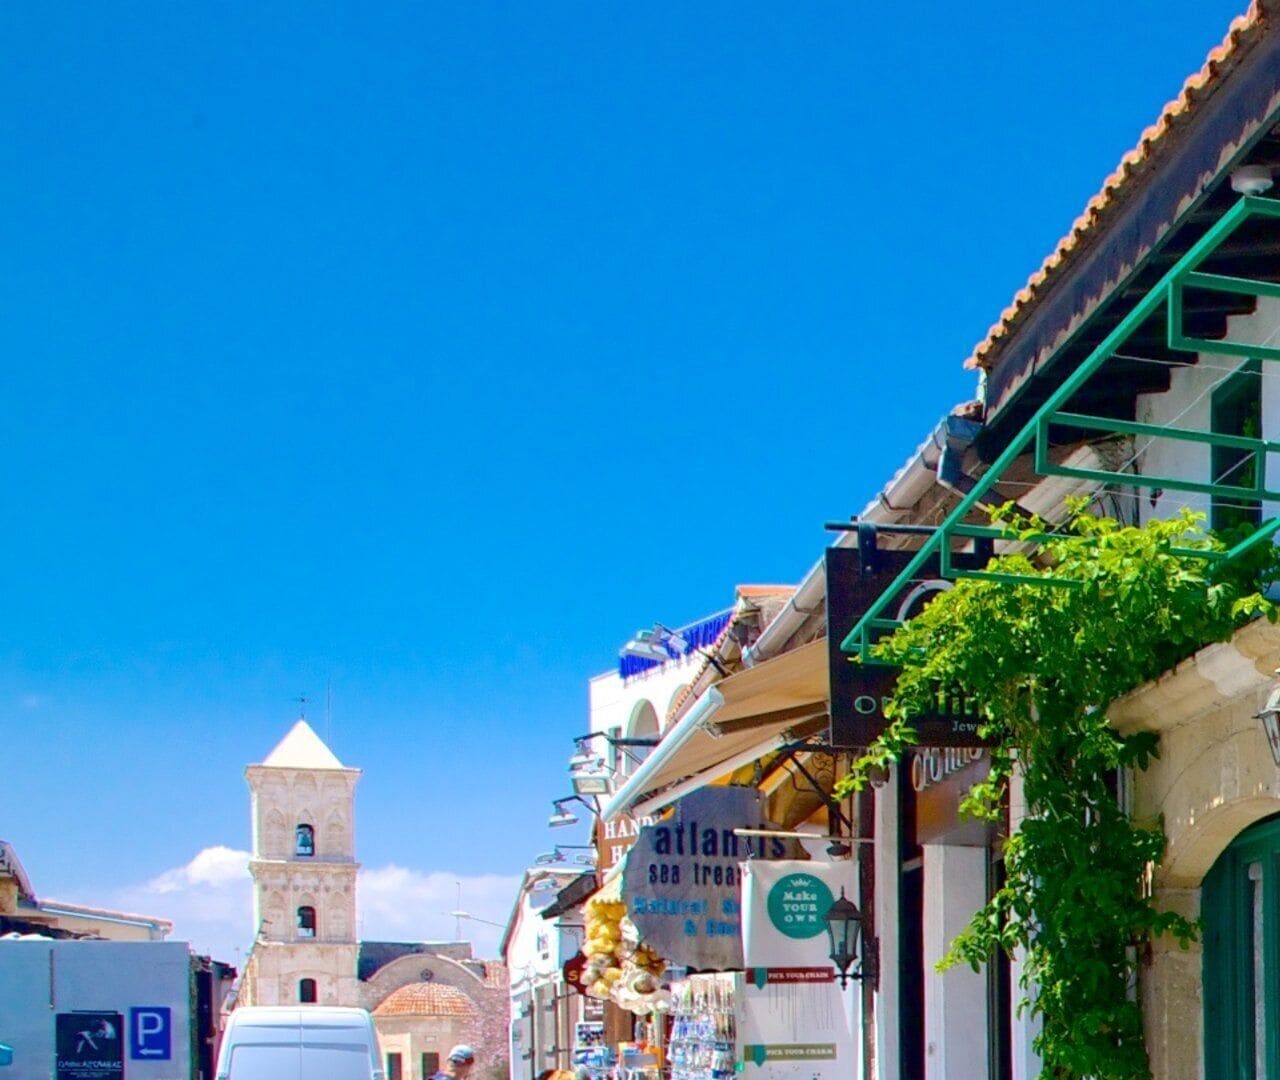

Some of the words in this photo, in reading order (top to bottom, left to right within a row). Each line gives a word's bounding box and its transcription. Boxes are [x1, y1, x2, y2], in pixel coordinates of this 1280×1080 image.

[656, 822, 786, 857] atlantis
[649, 863, 680, 885] sea
[783, 890, 818, 901] Make
[783, 903, 818, 912] YOUR
[784, 914, 818, 922] OWN
[137, 1012, 163, 1046] P
